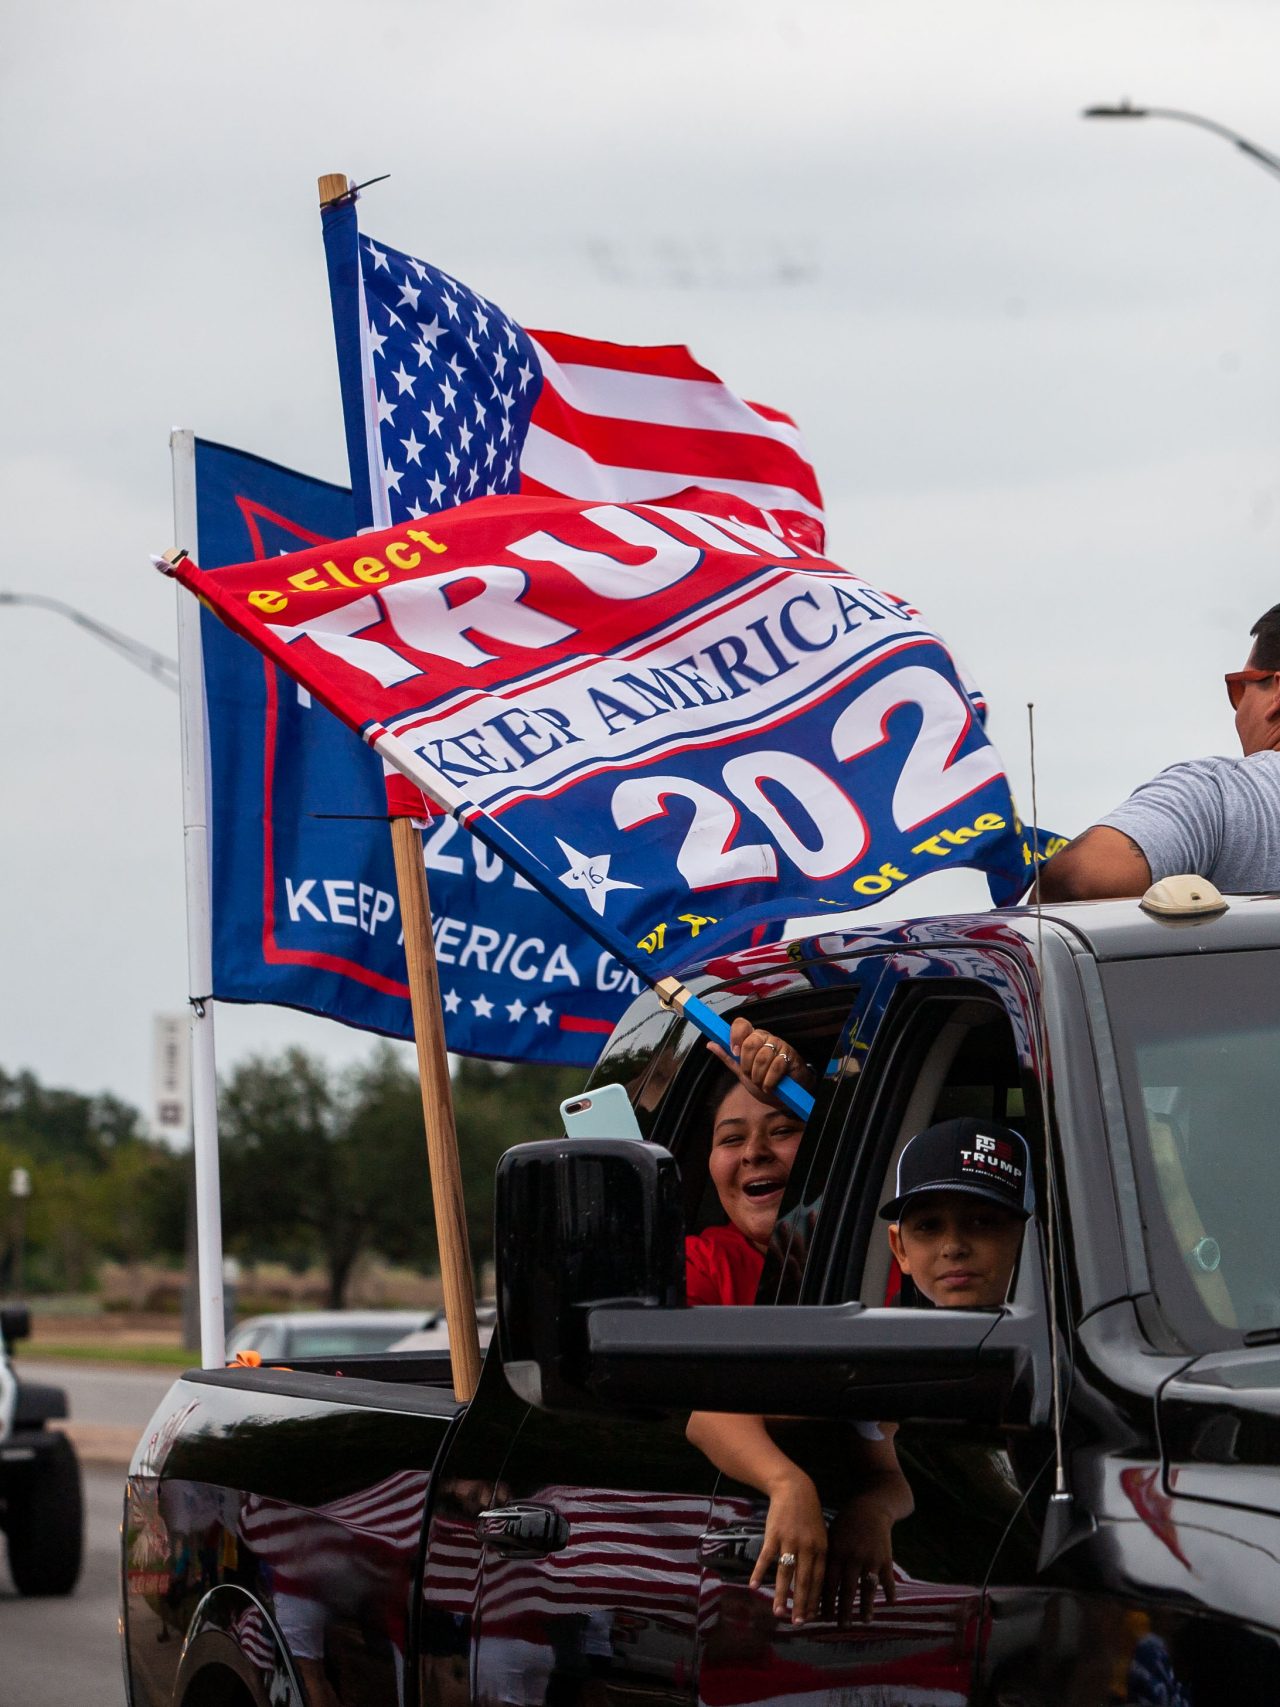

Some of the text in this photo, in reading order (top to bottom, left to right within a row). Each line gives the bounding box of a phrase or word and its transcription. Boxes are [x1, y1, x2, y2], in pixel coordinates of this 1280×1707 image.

[413, 584, 886, 788] KEEP AMERICA
[611, 665, 1006, 893] 202
[852, 862, 909, 896] Of
[912, 811, 1006, 858] The
[285, 877, 395, 936] KEEP
[397, 911, 581, 987] ERICA
[960, 1150, 1022, 1177] TRUMP
